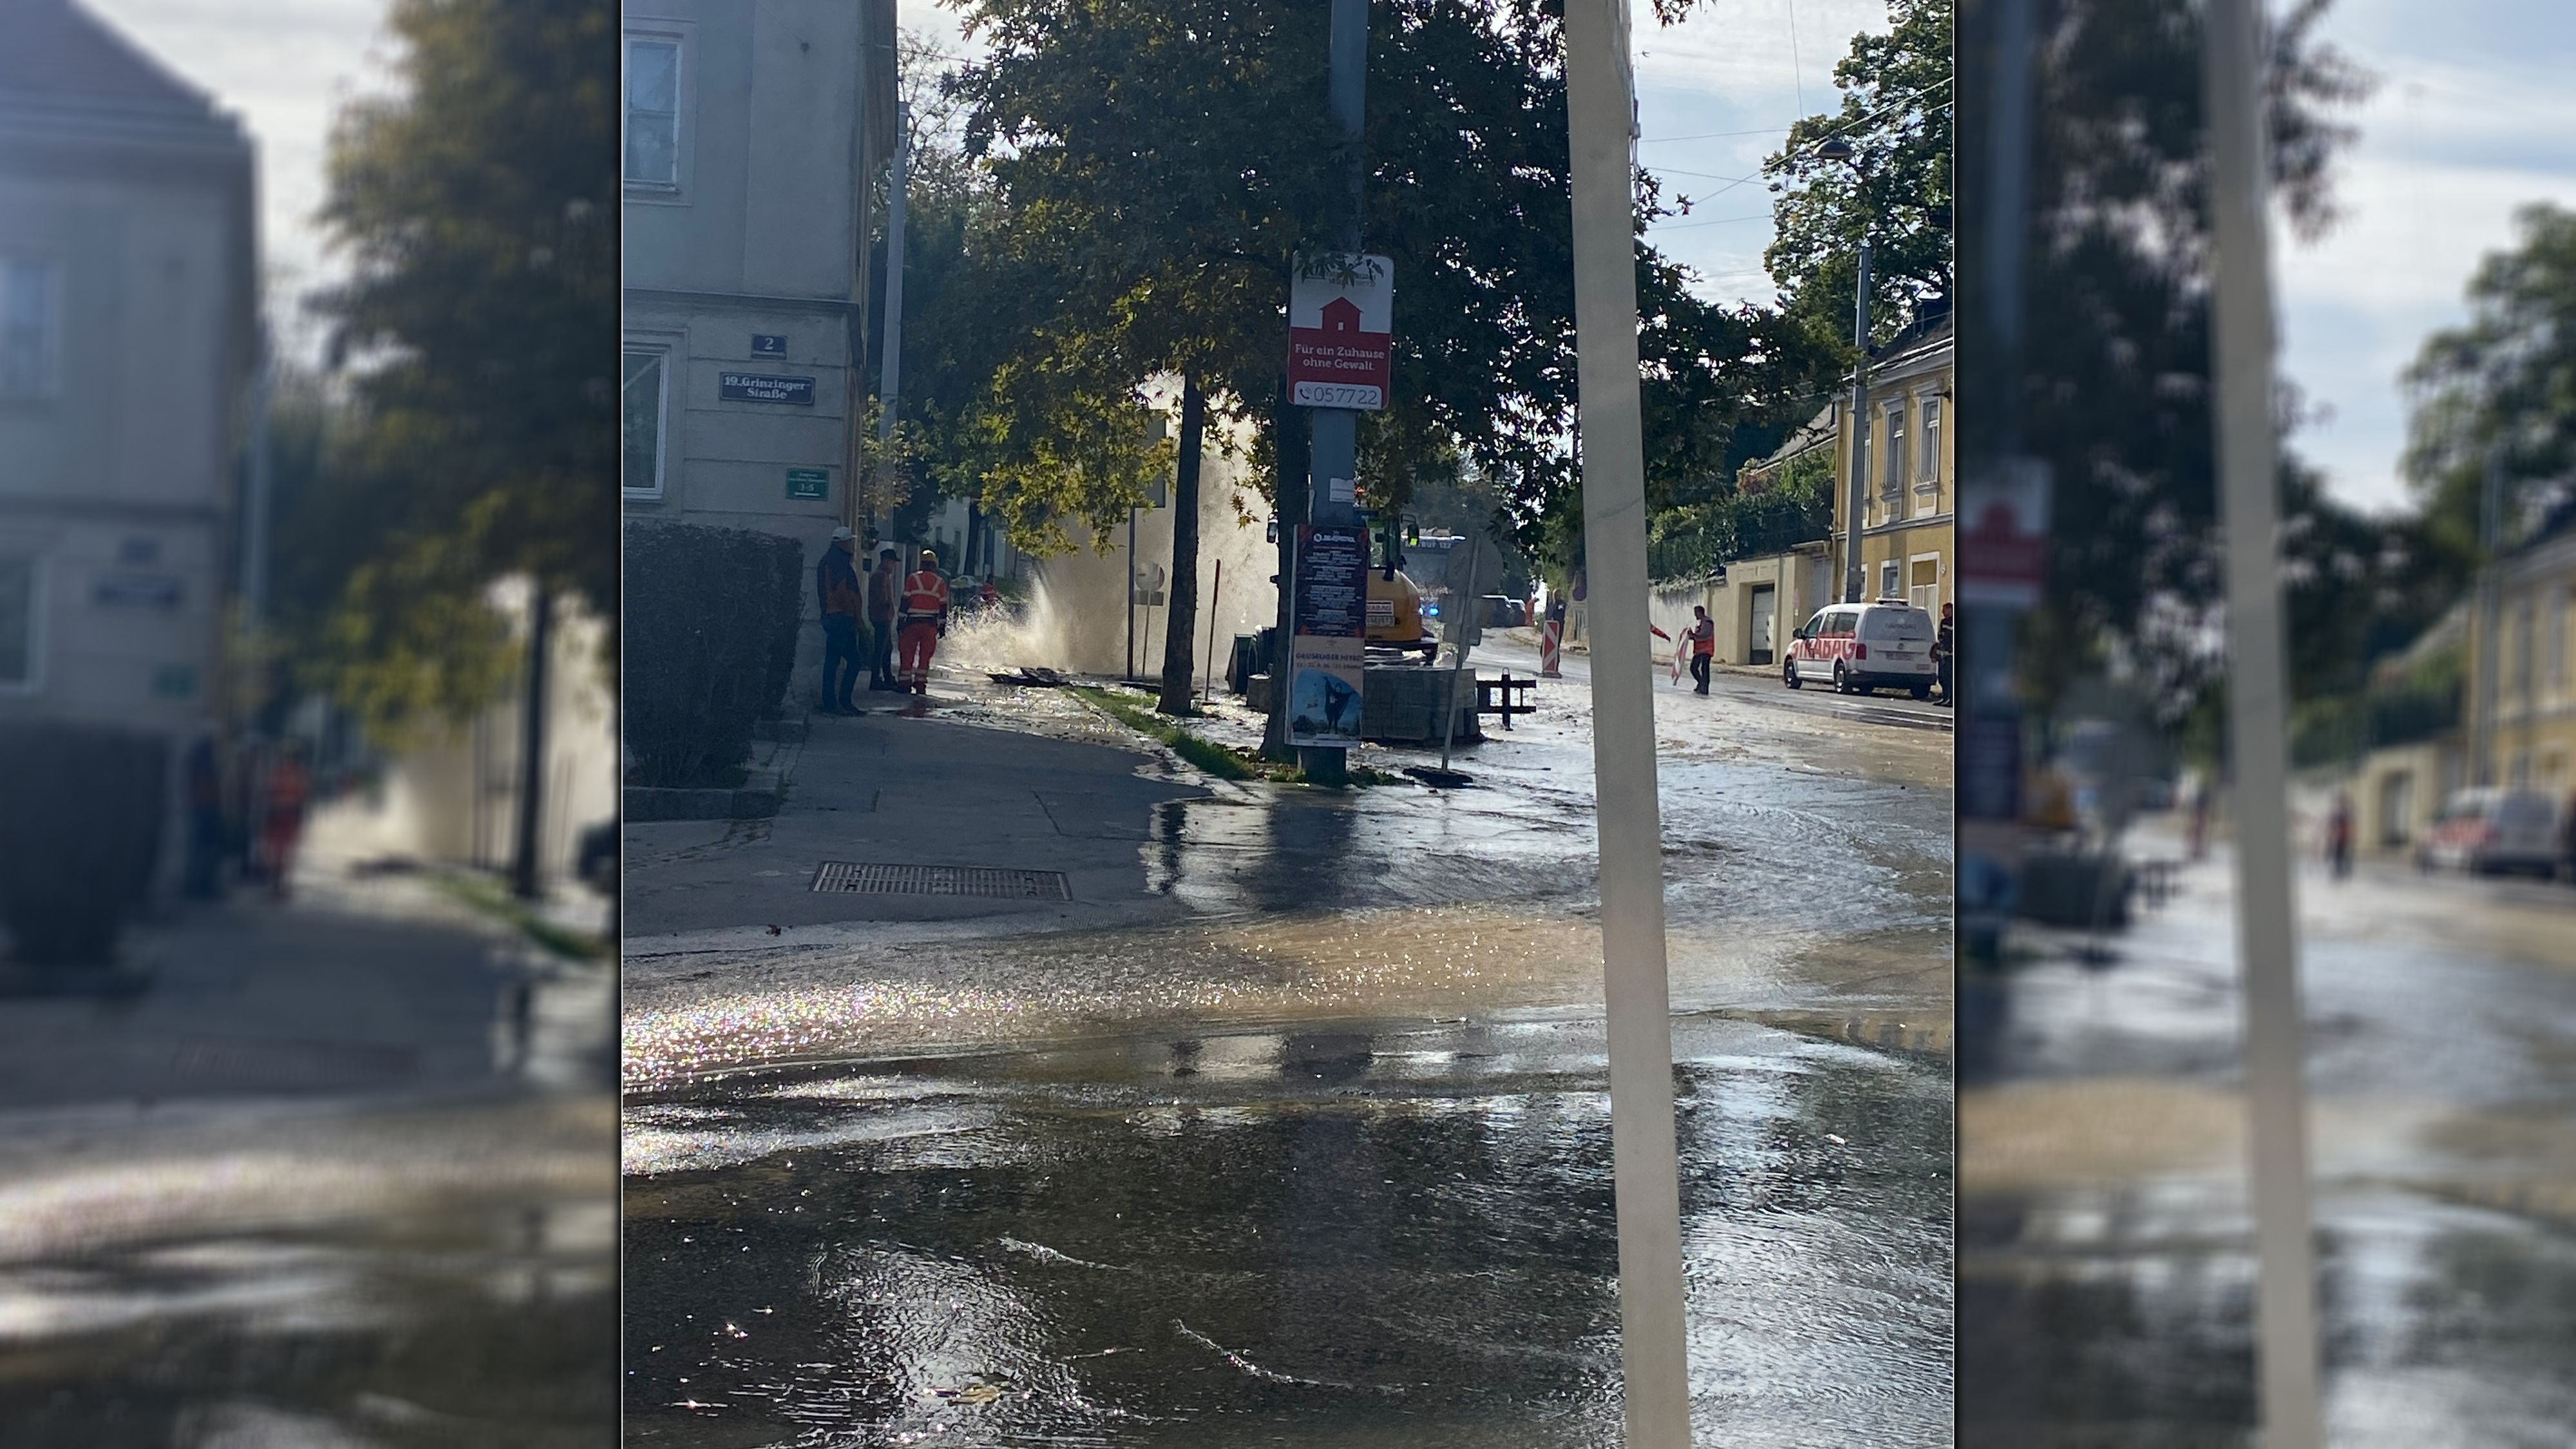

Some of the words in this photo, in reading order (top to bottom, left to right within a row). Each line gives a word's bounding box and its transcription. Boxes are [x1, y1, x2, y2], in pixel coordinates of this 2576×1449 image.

[764, 337, 774, 350] 2
[1294, 343, 1314, 354] Für
[1316, 345, 1334, 355] ein
[1337, 346, 1385, 359] Zuhause
[1303, 357, 1332, 368] ohne
[1334, 359, 1375, 371] Gewalt.
[746, 387, 788, 399] Straße
